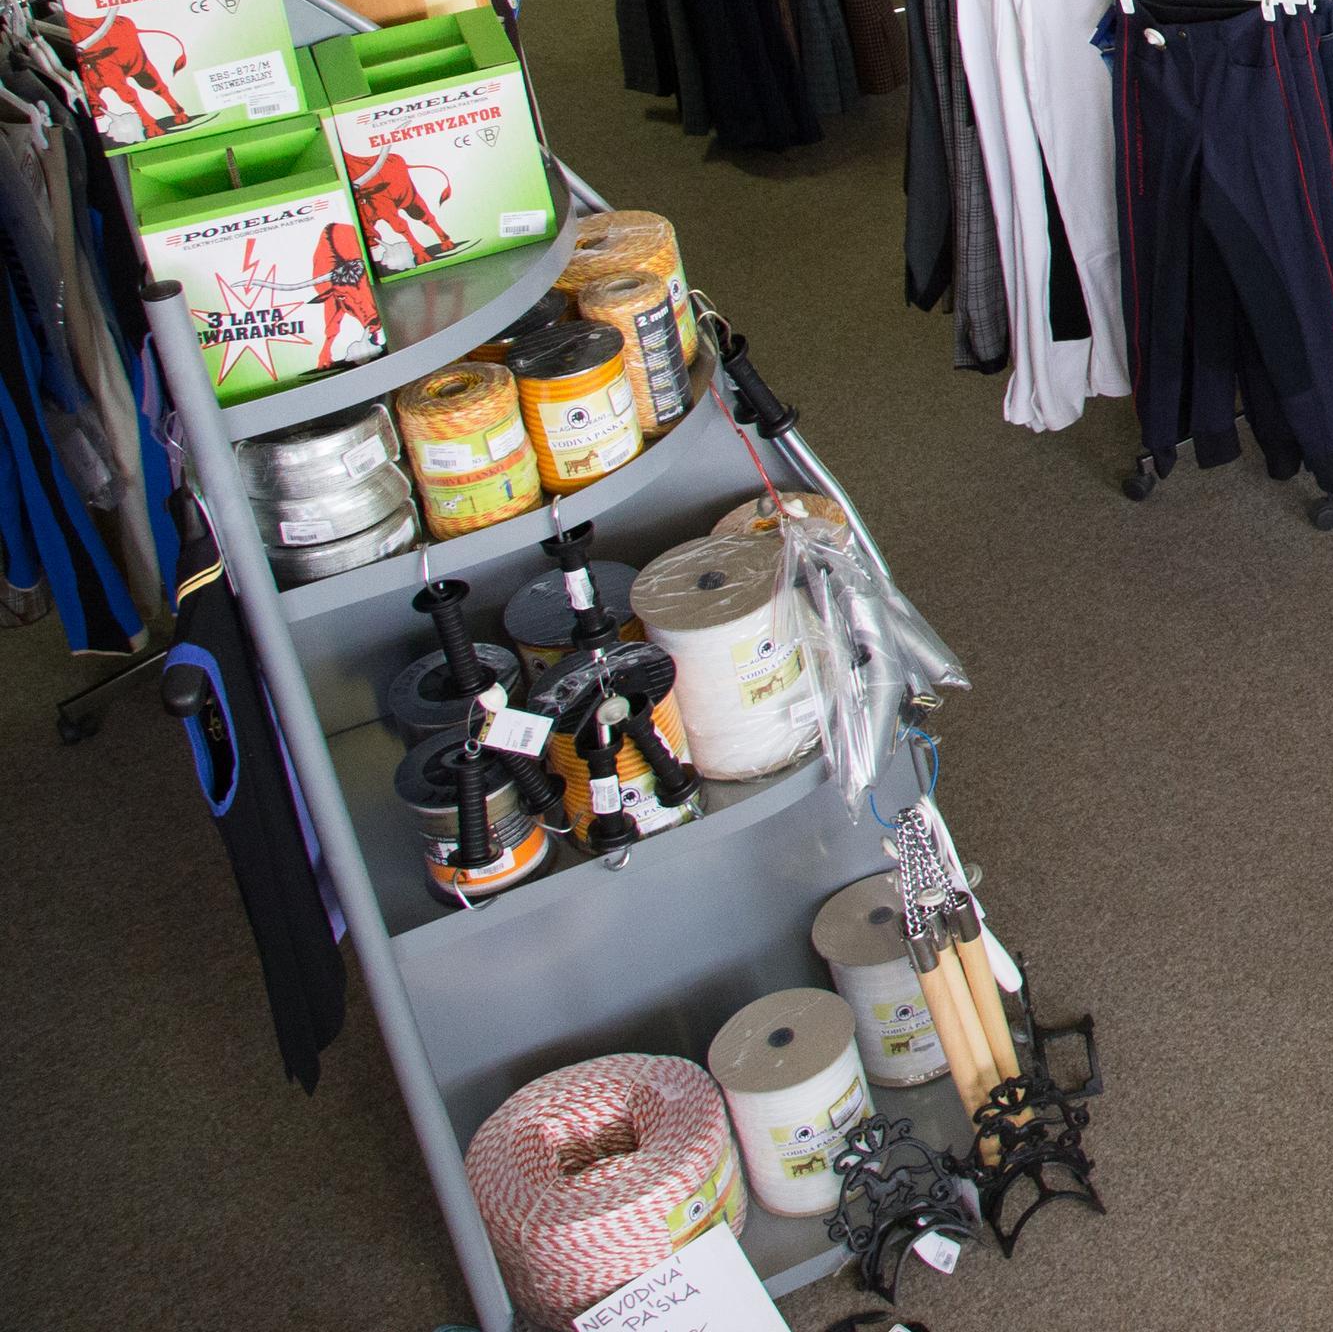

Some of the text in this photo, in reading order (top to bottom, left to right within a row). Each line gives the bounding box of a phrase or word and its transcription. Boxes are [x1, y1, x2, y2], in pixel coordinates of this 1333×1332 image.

[209, 60, 271, 82] EBS-872/M
[212, 70, 274, 93] UNIWERSALNY
[372, 86, 489, 121] POMELAC
[368, 106, 502, 149] ELEKTRYZATOR
[183, 205, 313, 243] POMELAC
[207, 308, 284, 329] 3 LATA
[636, 304, 670, 328] 2 mm
[620, 1282, 702, 1332] PÁSKA
